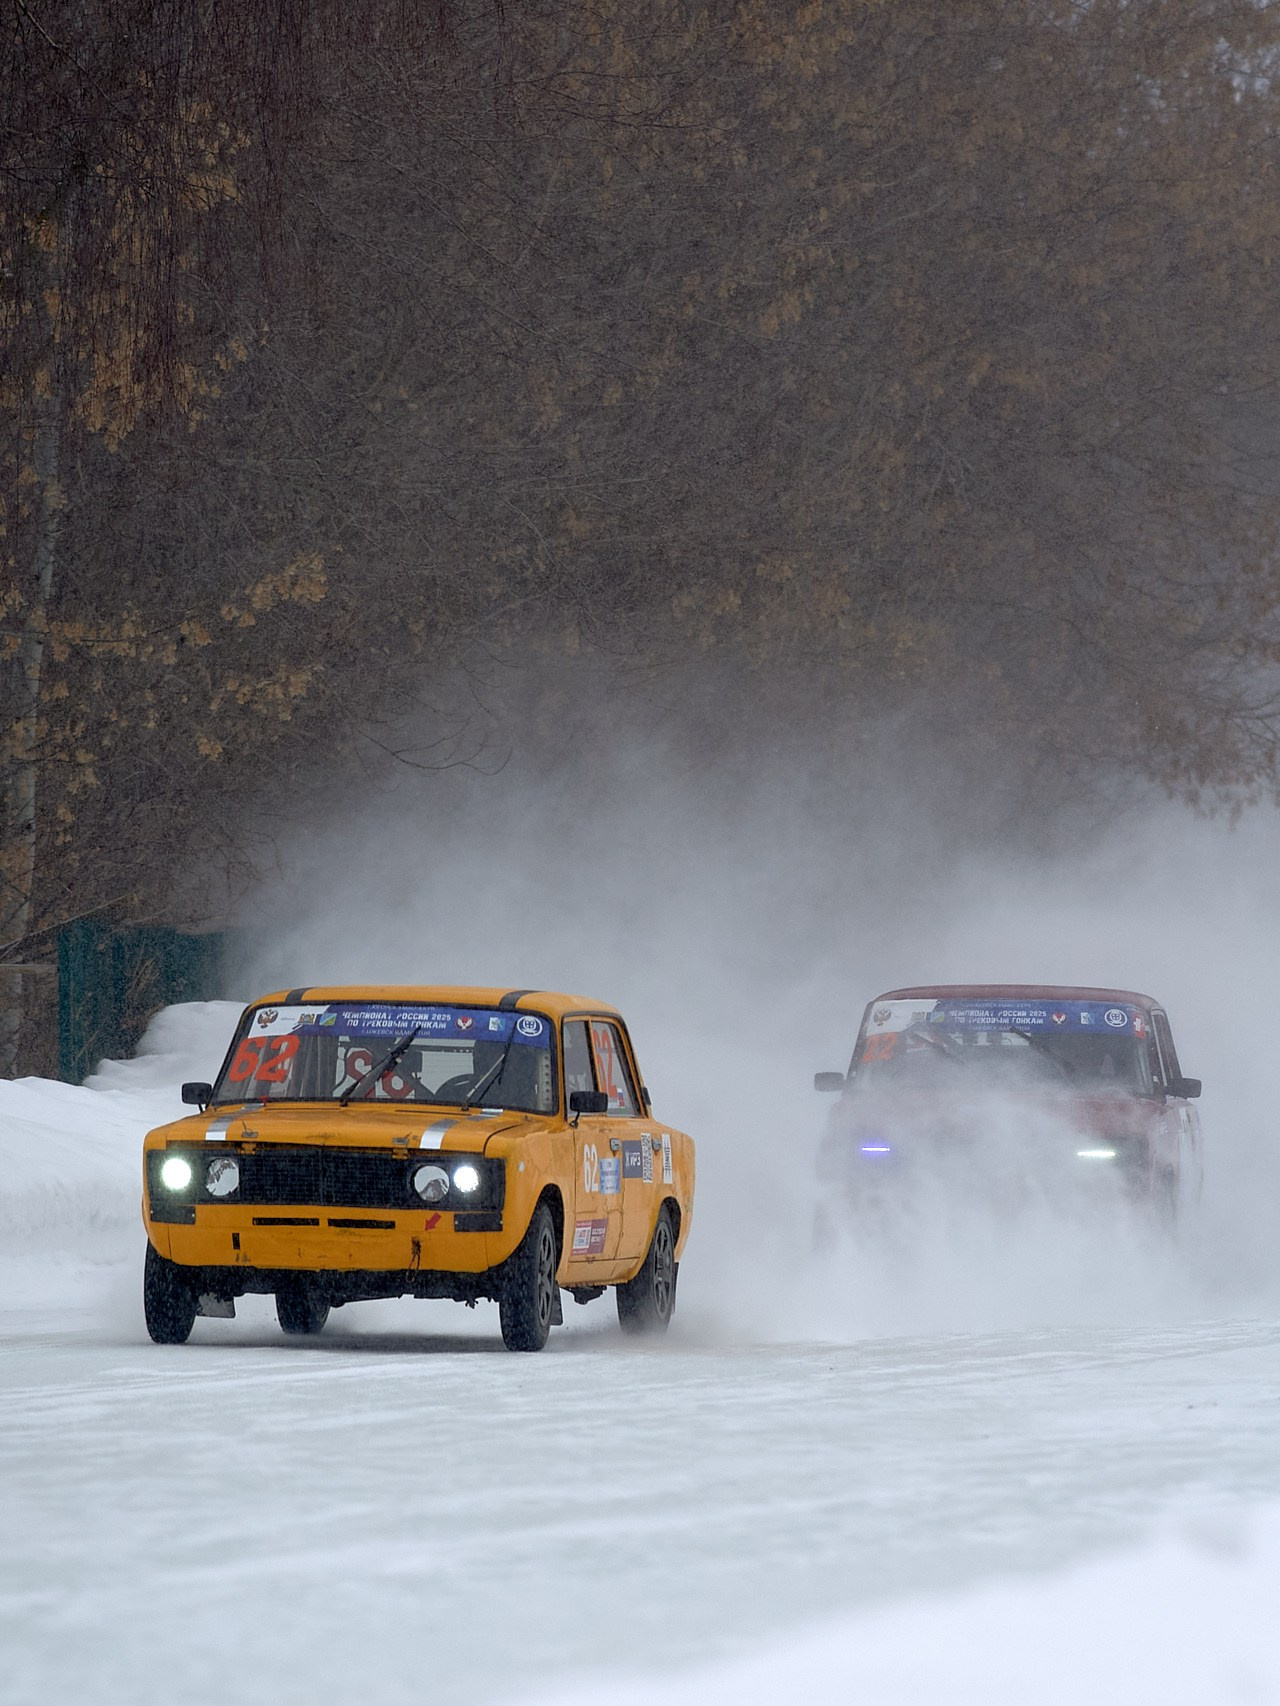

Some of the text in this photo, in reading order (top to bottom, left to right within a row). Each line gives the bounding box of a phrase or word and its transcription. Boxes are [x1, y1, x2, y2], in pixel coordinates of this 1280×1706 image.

[342, 1011, 451, 1021] ЧЕМПИОНАТ РОССИИ 2025
[347, 1019, 358, 1027] ПО
[228, 1034, 300, 1083] 62
[593, 1029, 617, 1099] 62
[862, 1032, 897, 1064] 22
[584, 1144, 598, 1193] 62
